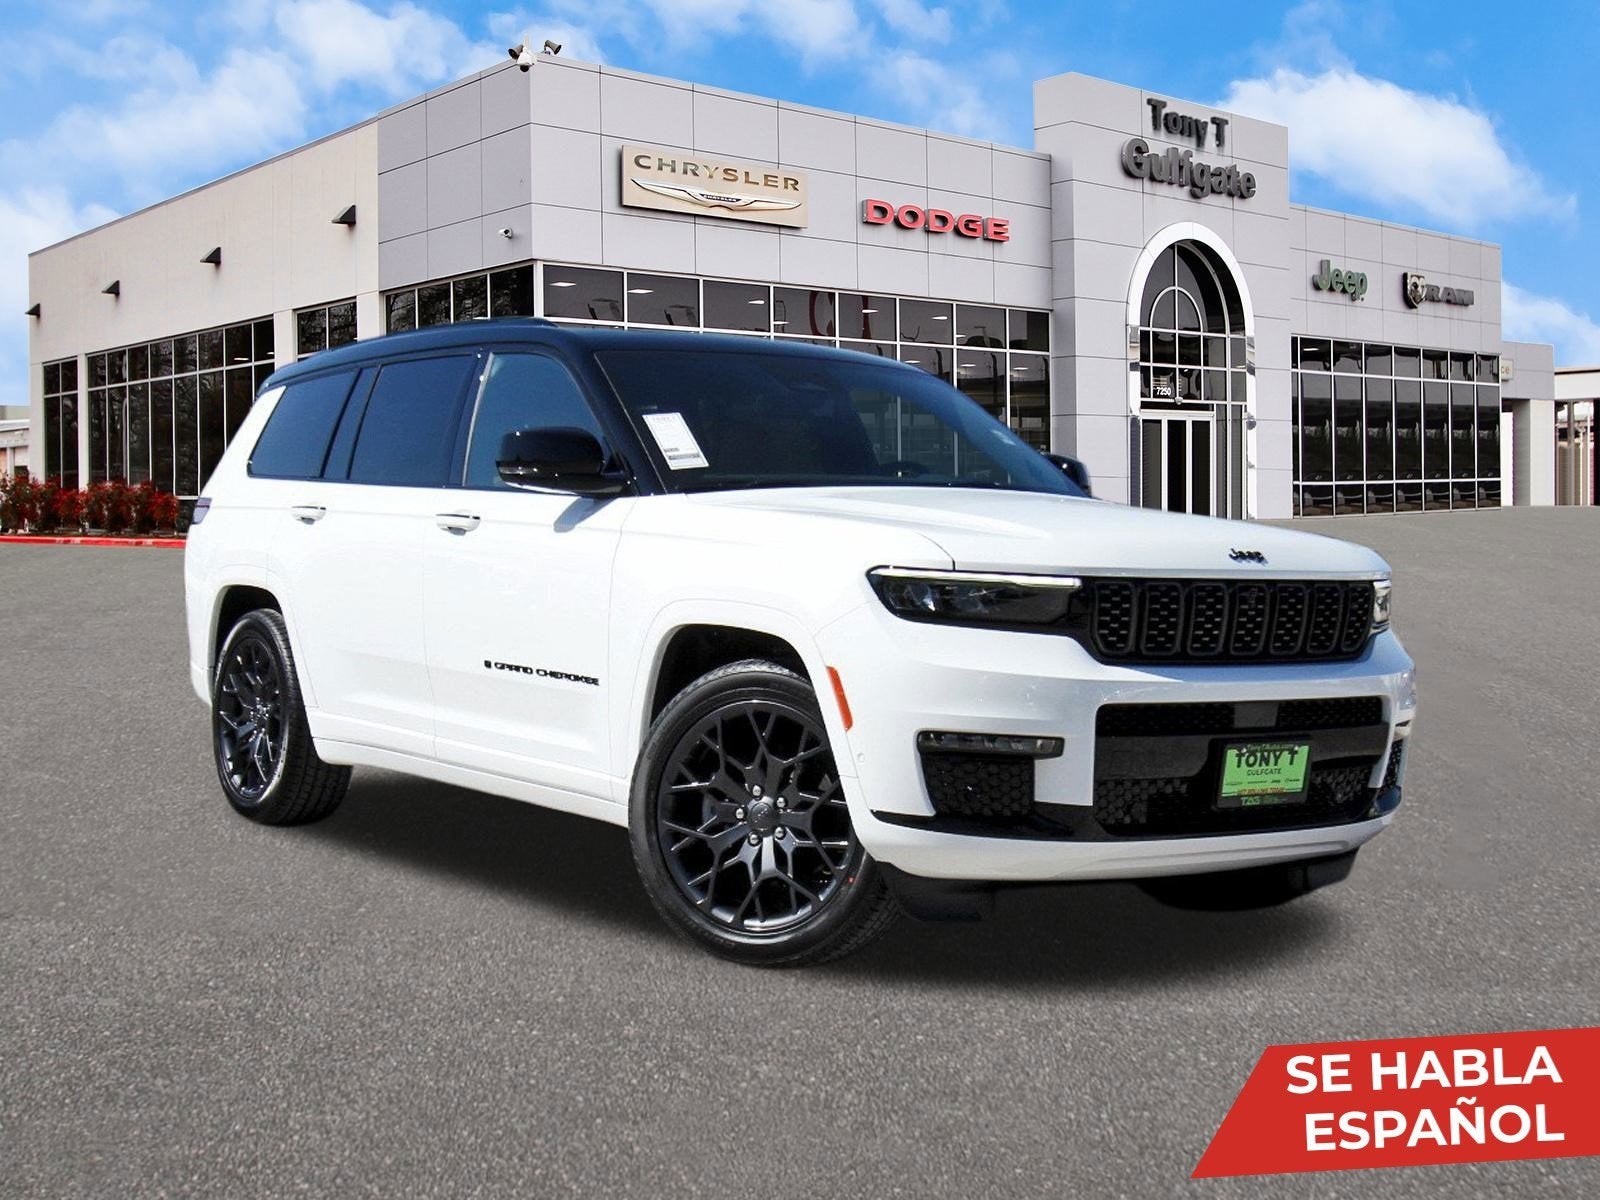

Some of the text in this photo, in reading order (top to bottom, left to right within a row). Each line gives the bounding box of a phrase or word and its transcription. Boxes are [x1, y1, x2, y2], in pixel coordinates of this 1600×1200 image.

[1147, 98, 1229, 148] Tony T
[634, 153, 800, 192] CHRYSLER
[1122, 138, 1257, 199] Gulfgate
[862, 198, 1010, 242] DODGE
[1312, 259, 1368, 302] Jeep
[1426, 284, 1474, 306] RAM
[1156, 387, 1172, 396] 7250
[494, 661, 600, 686] GRAND CHEROKEE
[1235, 749, 1298, 768] TONY T
